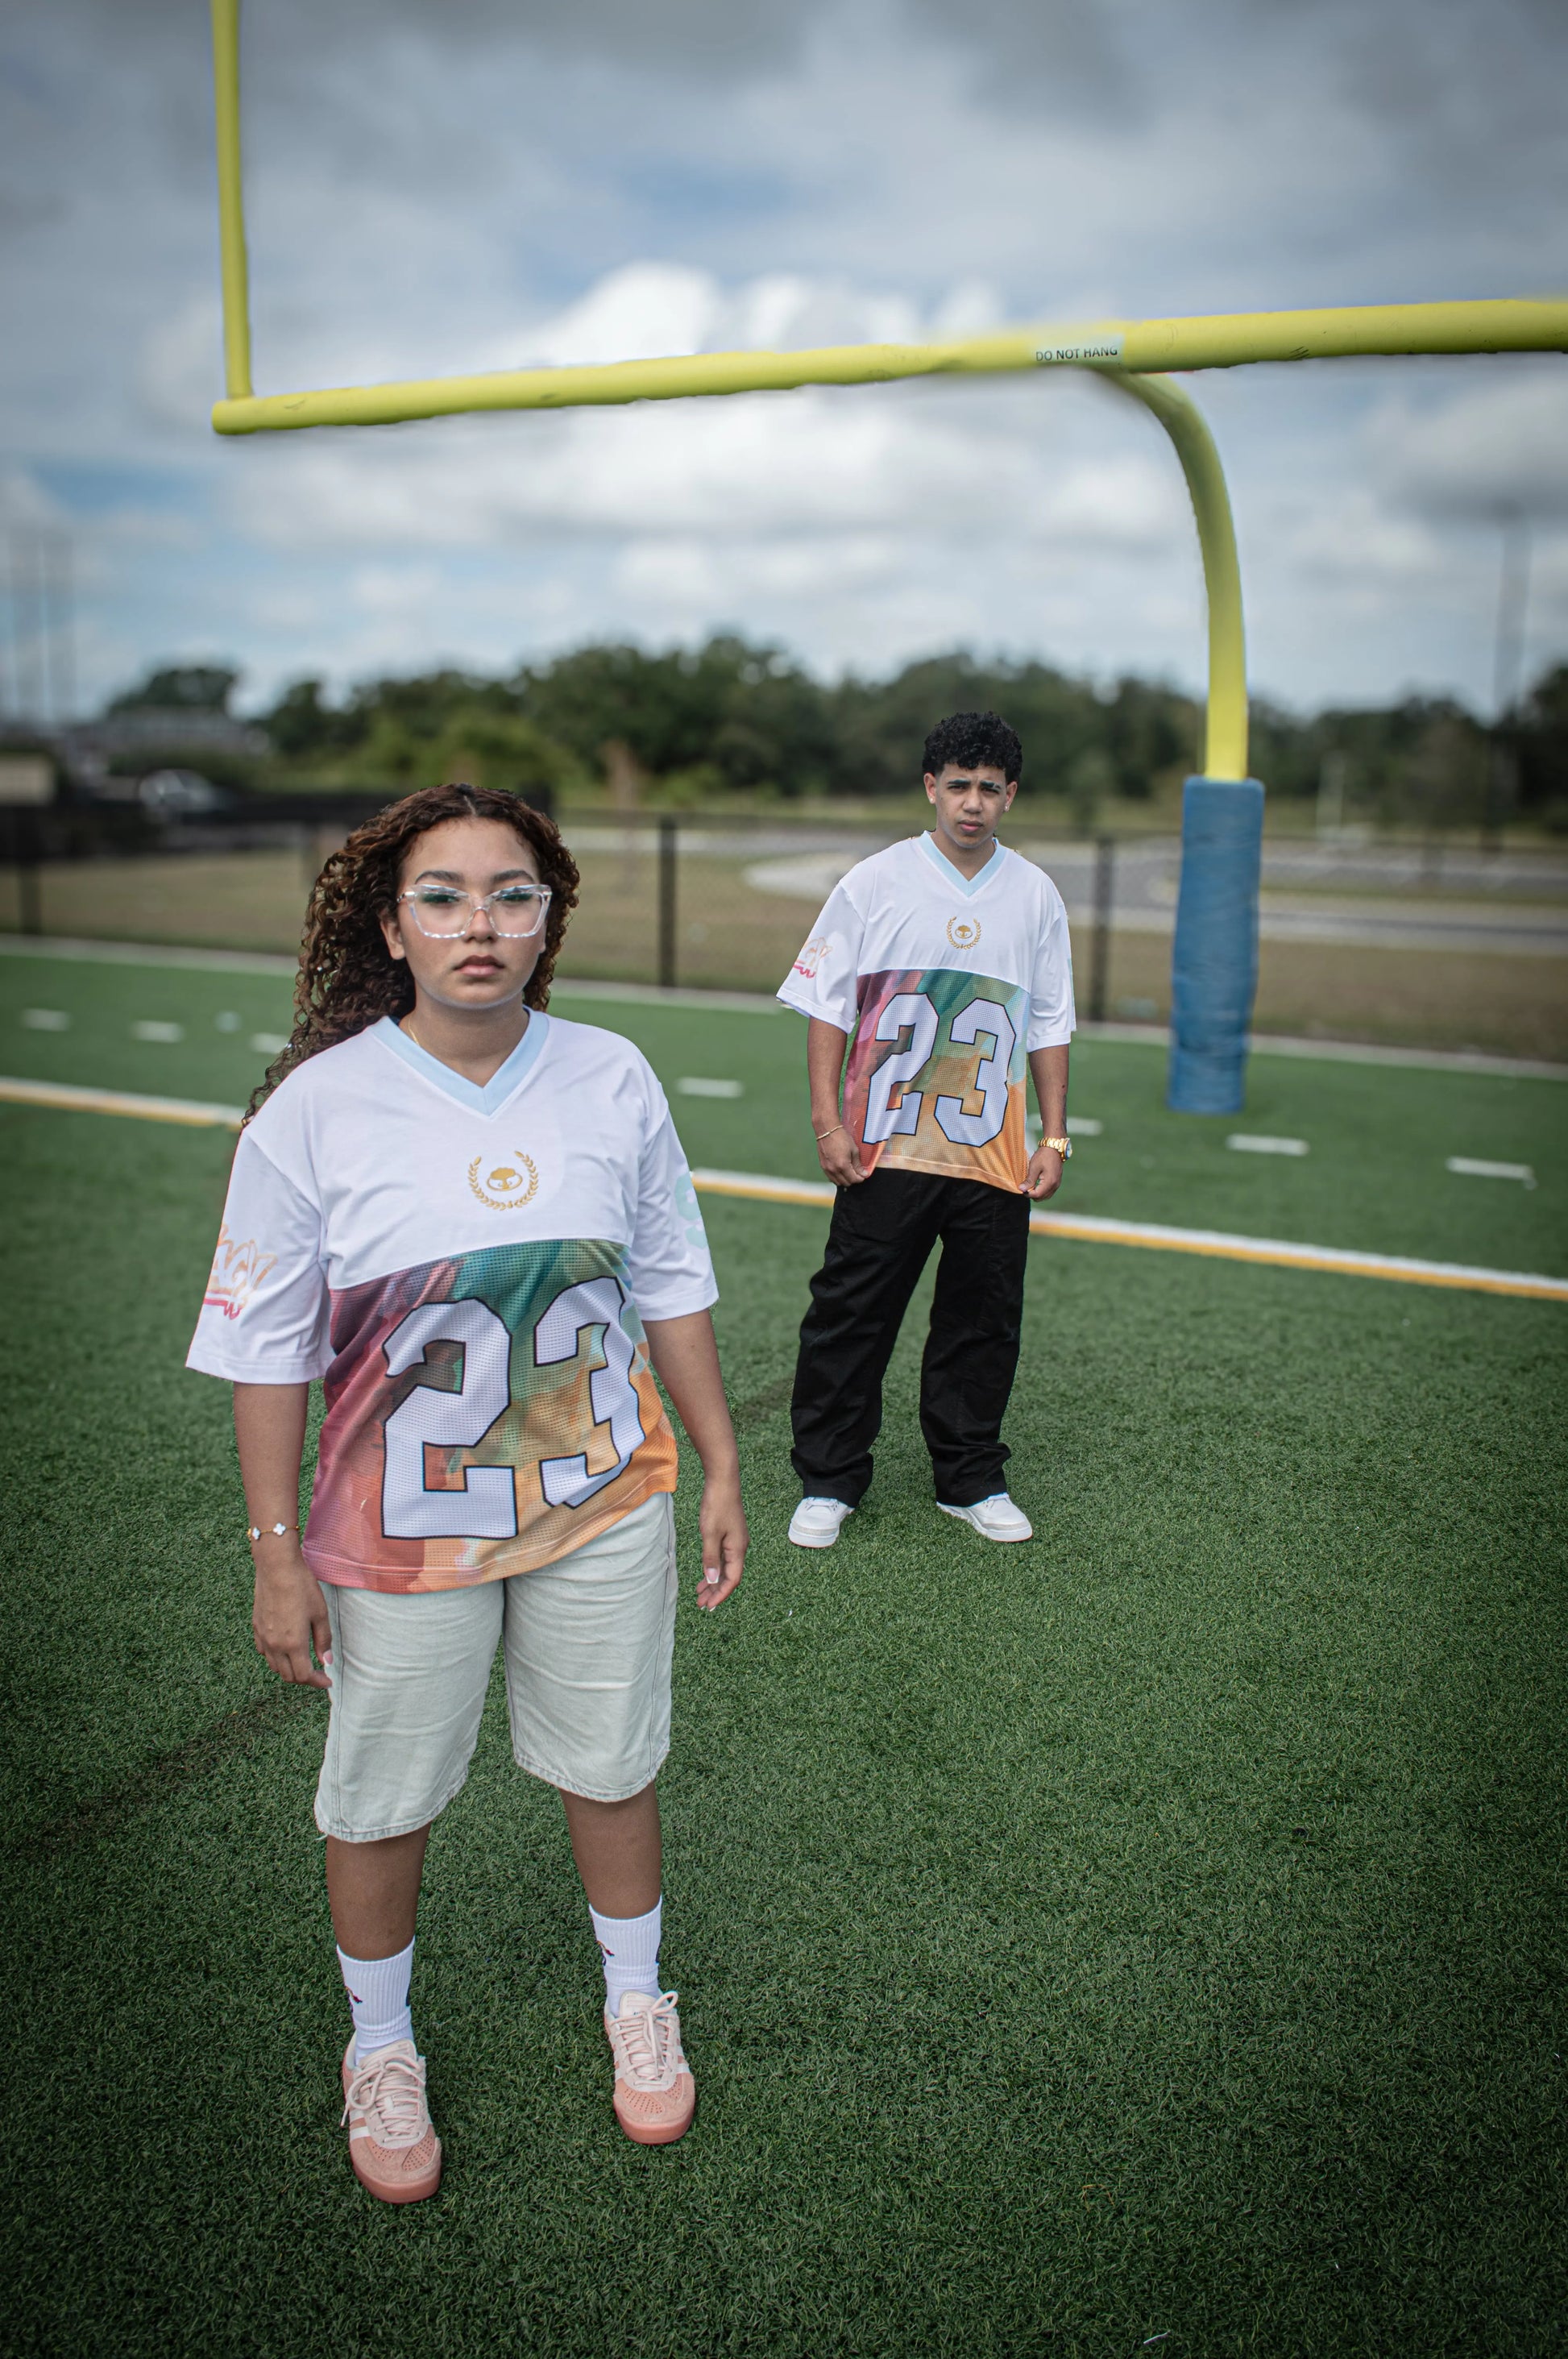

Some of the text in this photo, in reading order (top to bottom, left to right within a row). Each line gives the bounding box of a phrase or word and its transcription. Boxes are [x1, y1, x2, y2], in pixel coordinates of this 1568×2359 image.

[1035, 346, 1118, 362] DO NOT HANG
[862, 992, 1017, 1148] 23
[382, 1276, 646, 1540] 23
